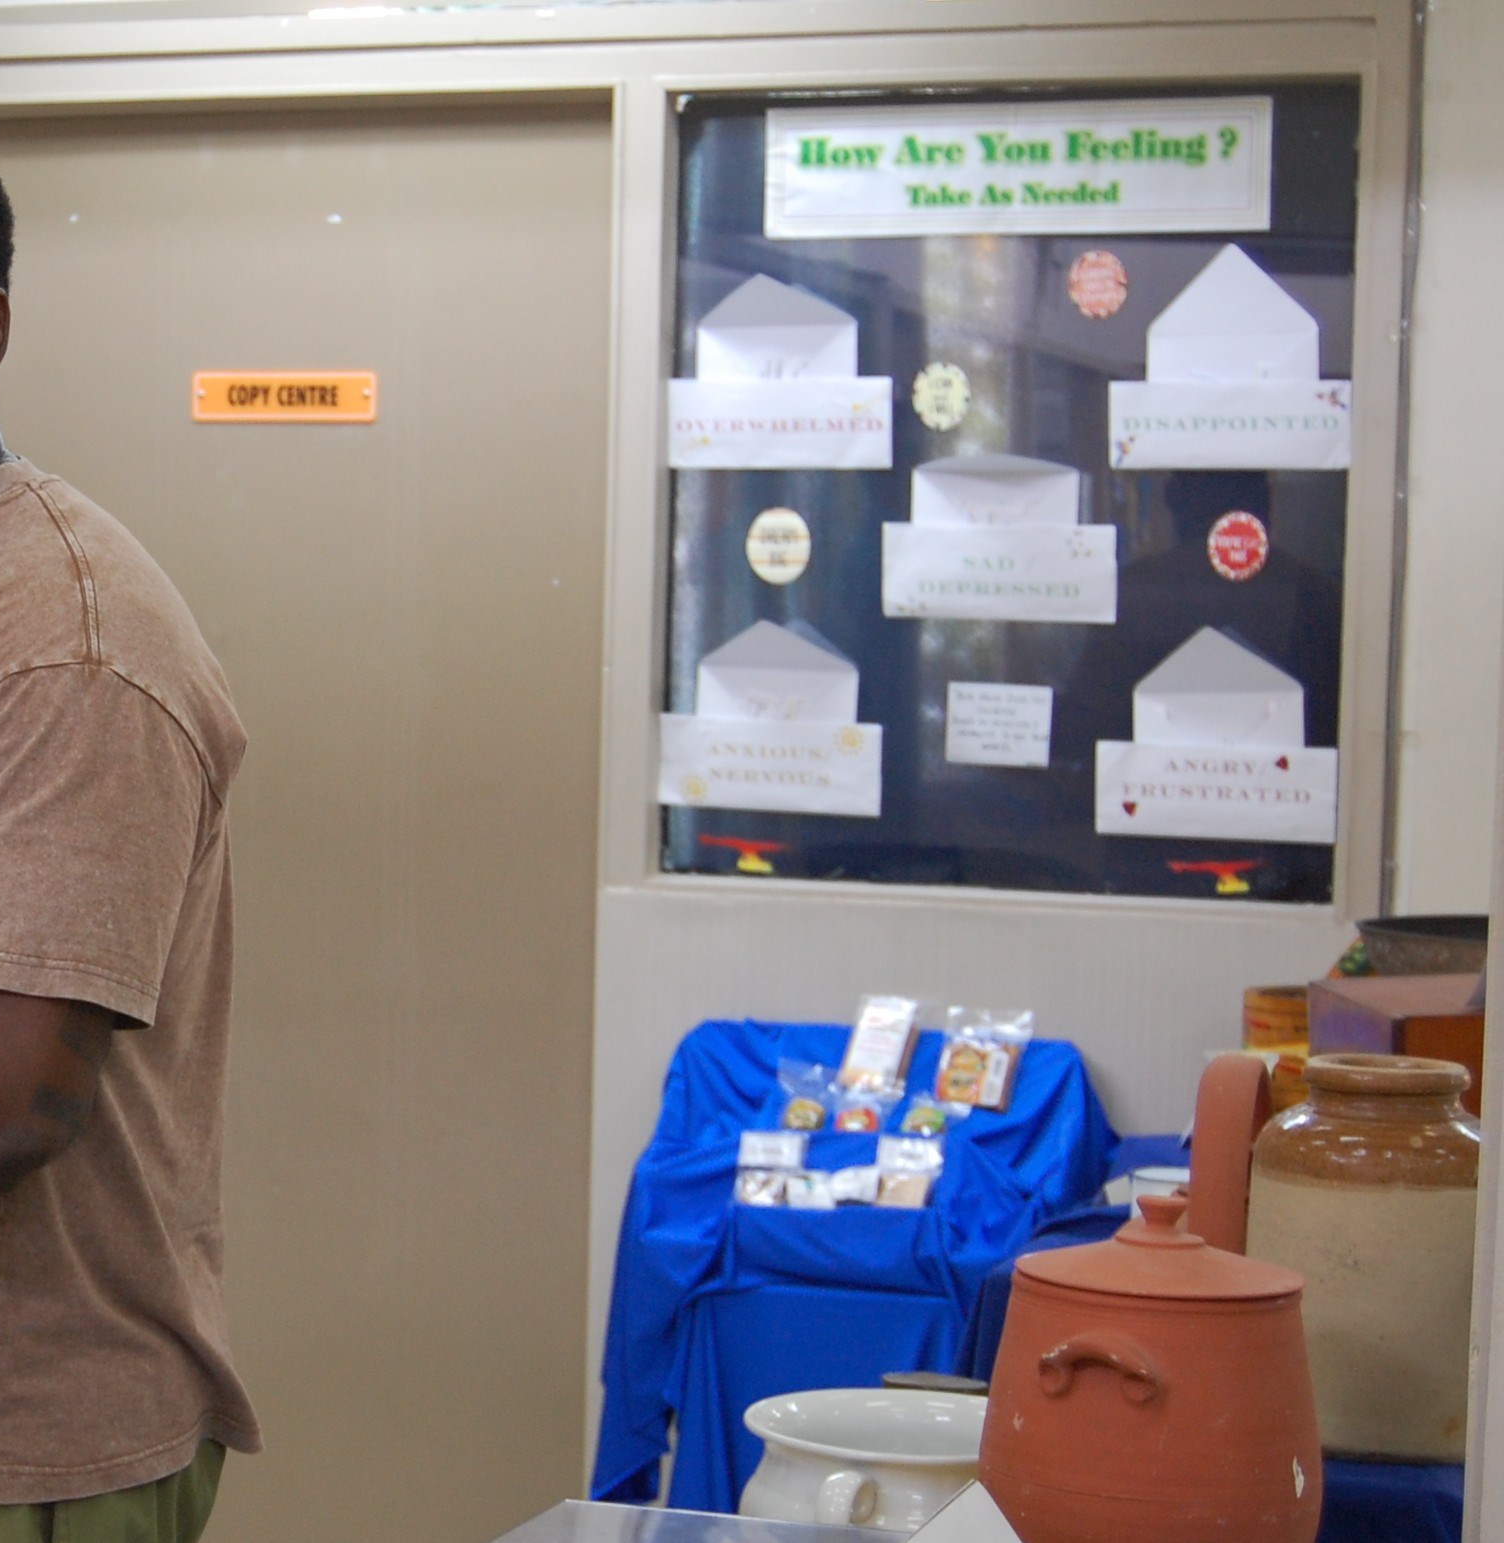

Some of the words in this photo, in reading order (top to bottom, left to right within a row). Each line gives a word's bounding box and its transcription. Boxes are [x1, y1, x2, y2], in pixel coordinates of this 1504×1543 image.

[798, 136, 883, 168] How
[897, 135, 963, 166] Are
[977, 132, 1051, 164] You
[1065, 128, 1207, 166] Feeling
[906, 184, 972, 207] Take
[980, 184, 1014, 206] As
[1022, 181, 1120, 205] Needed
[227, 384, 270, 407] COPY
[277, 384, 339, 407] CENTRE
[675, 416, 885, 433] OVERWHELMED
[1122, 415, 1340, 432] DISAPPOINTED
[963, 555, 1015, 571] SAD
[918, 580, 1081, 598] DEPRESSED
[708, 767, 831, 786] NERVOUS
[1121, 782, 1312, 804] FRUSTRATED
